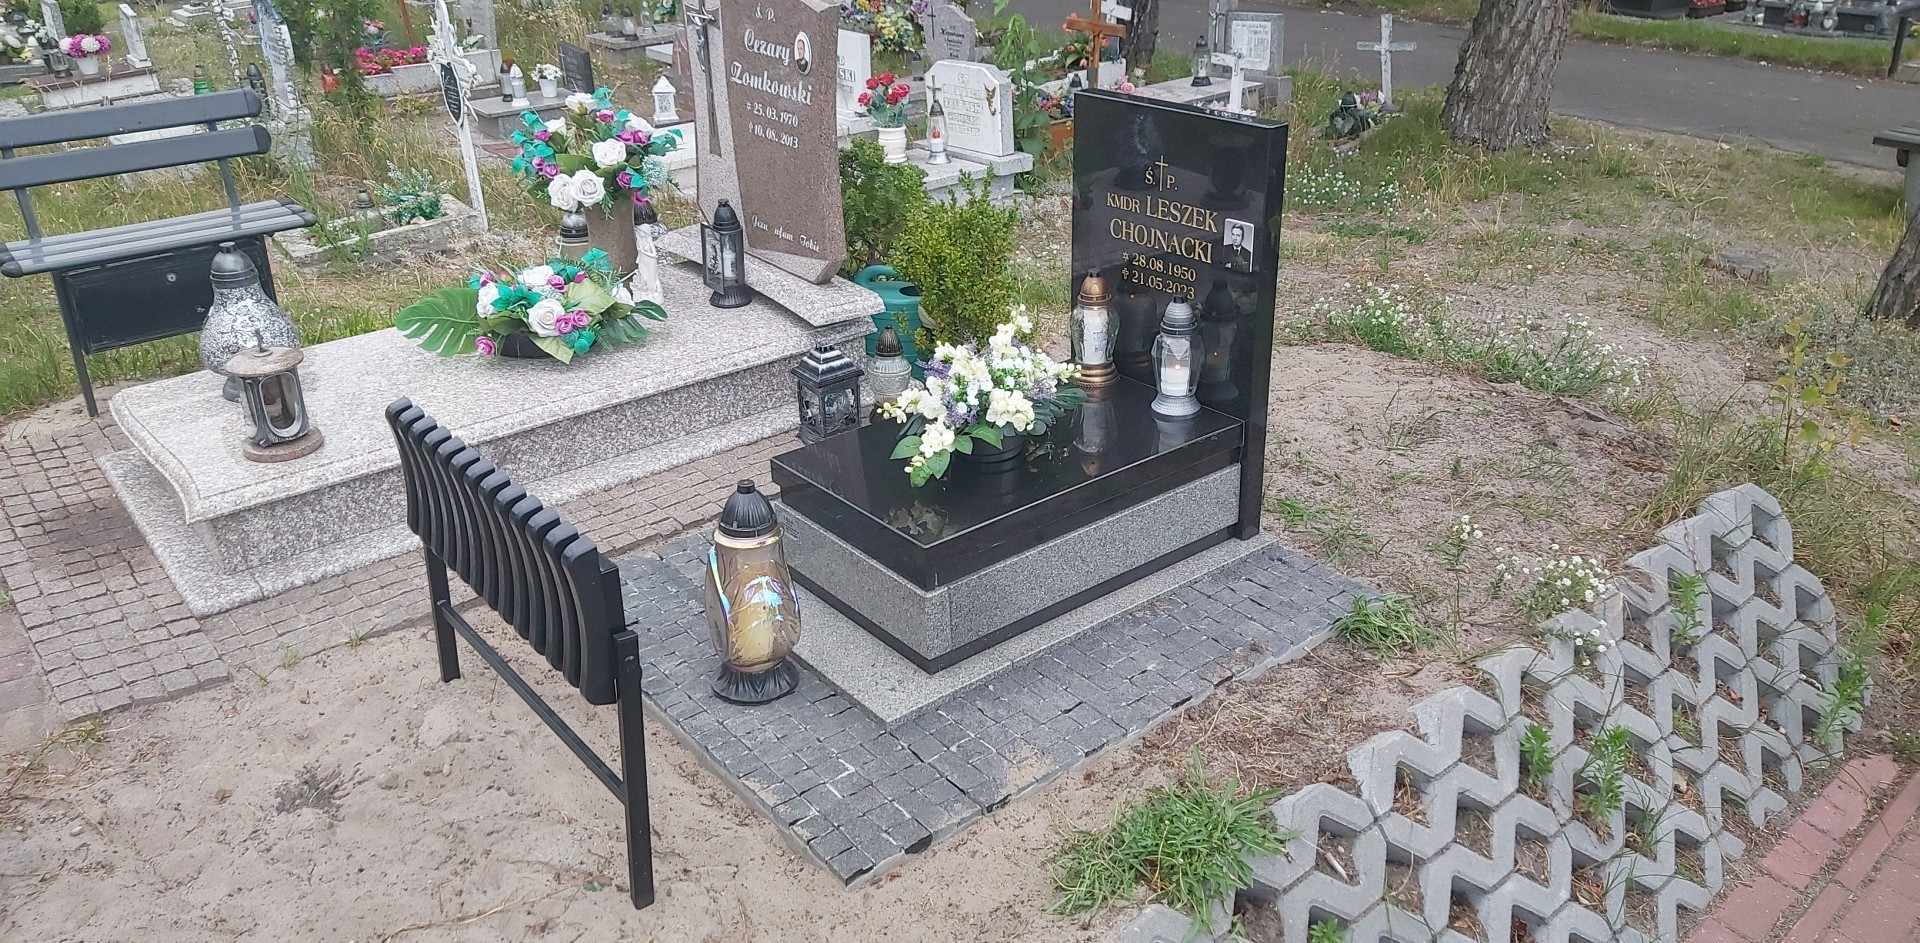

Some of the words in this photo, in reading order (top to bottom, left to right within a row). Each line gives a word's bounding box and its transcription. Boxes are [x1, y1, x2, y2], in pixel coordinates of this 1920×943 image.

[744, 28, 790, 66] Cezary
[1167, 175, 1178, 191] P.
[1106, 192, 1140, 214] KMDR
[1146, 194, 1218, 233] LESZEK
[1109, 218, 1213, 264] CHOJNACKI
[1132, 252, 1197, 282] 28.08.1950
